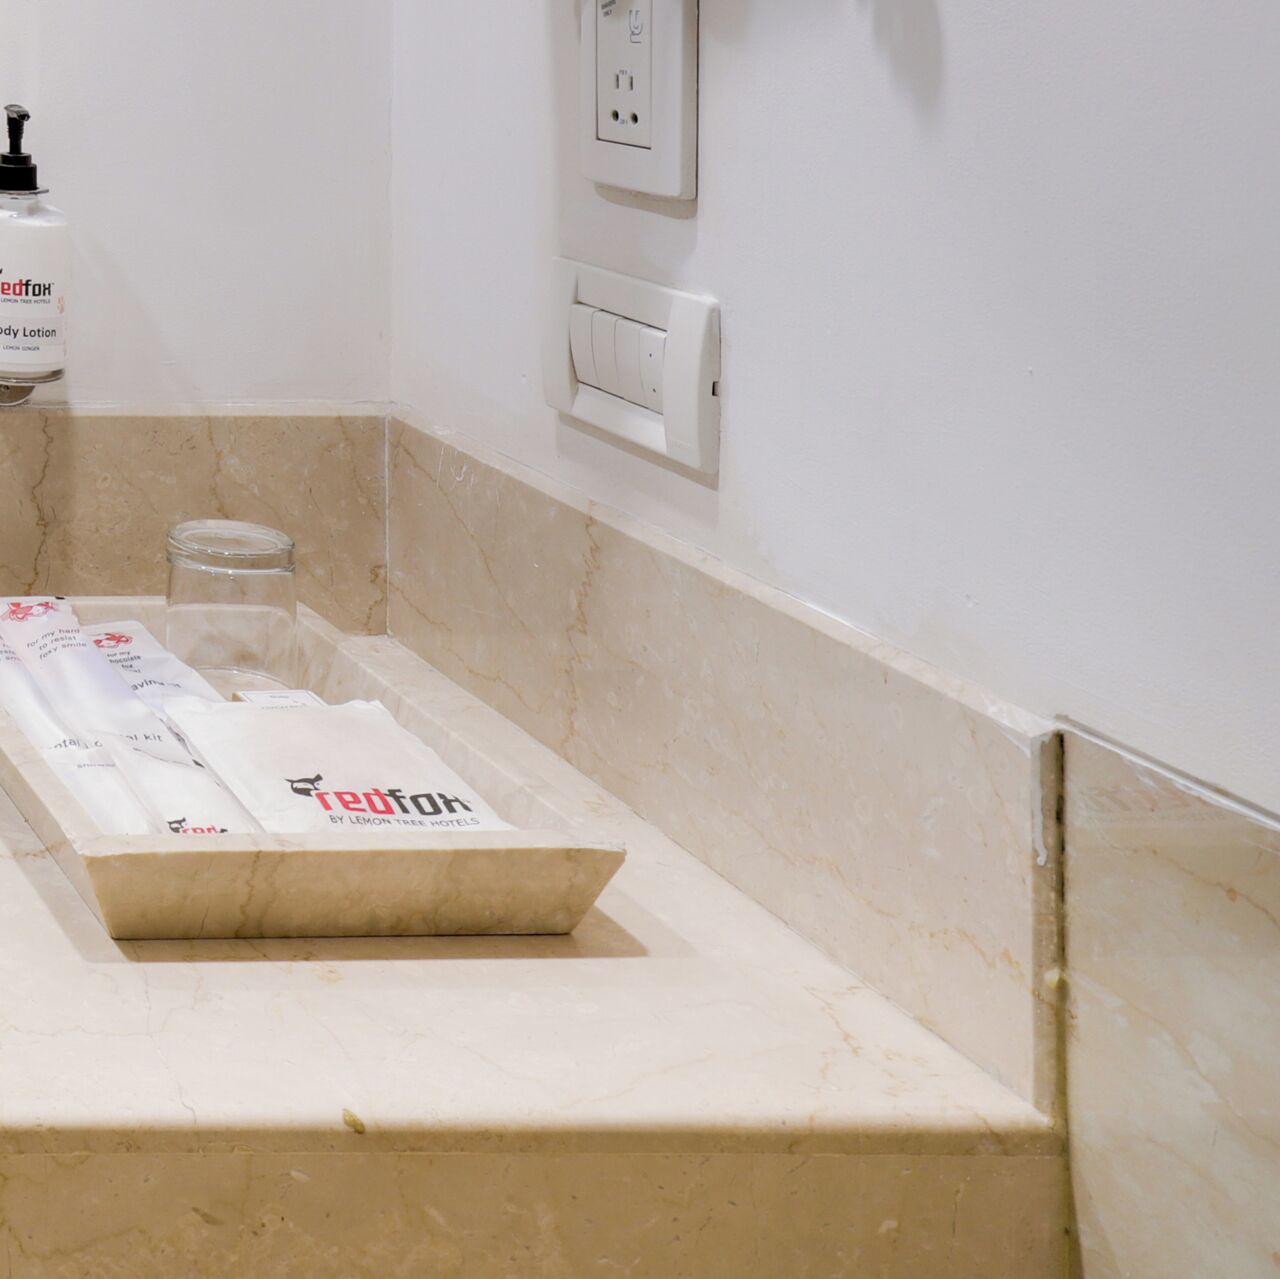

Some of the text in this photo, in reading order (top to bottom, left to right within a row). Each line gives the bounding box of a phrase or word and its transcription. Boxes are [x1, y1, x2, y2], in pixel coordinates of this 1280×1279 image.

[23, 326, 57, 338] Lotion
[26, 640, 39, 649] for
[41, 631, 56, 640] my
[39, 635, 77, 651] to resist
[39, 646, 58, 660] foxy
[143, 733, 163, 742] kit
[314, 787, 473, 816] redfox
[328, 814, 481, 828] BY LEMON TREE HOTELS
